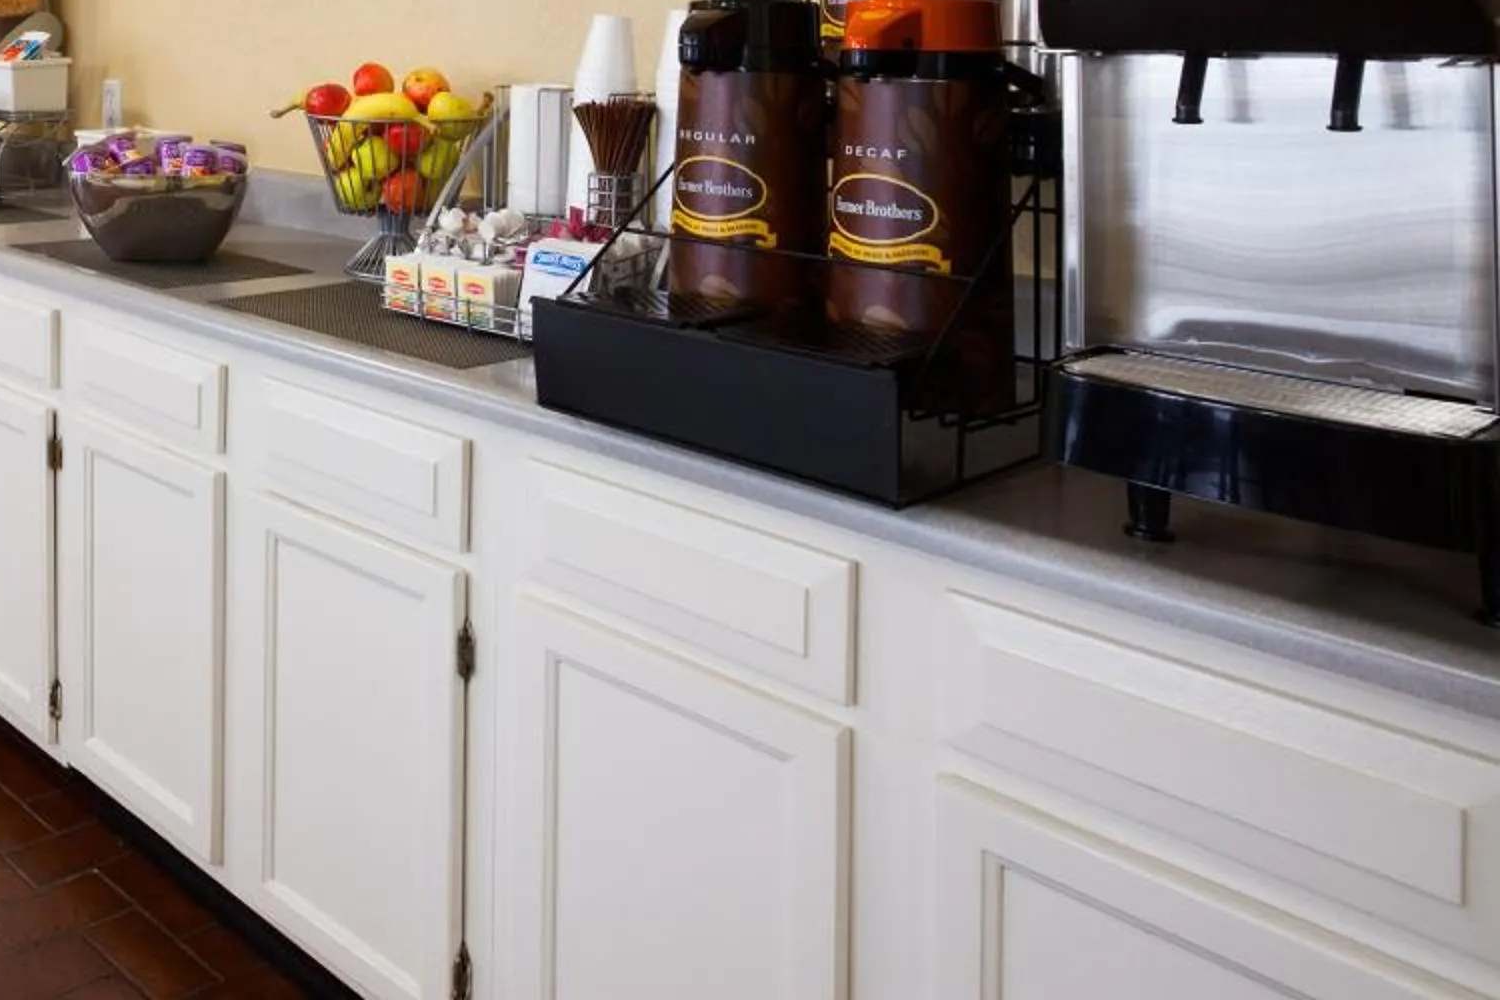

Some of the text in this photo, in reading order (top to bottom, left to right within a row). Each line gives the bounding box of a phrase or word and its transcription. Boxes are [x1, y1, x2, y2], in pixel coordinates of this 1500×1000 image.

[845, 145, 908, 161] DECAF
[704, 180, 754, 199] Brothers
[865, 199, 924, 221] Brothers
